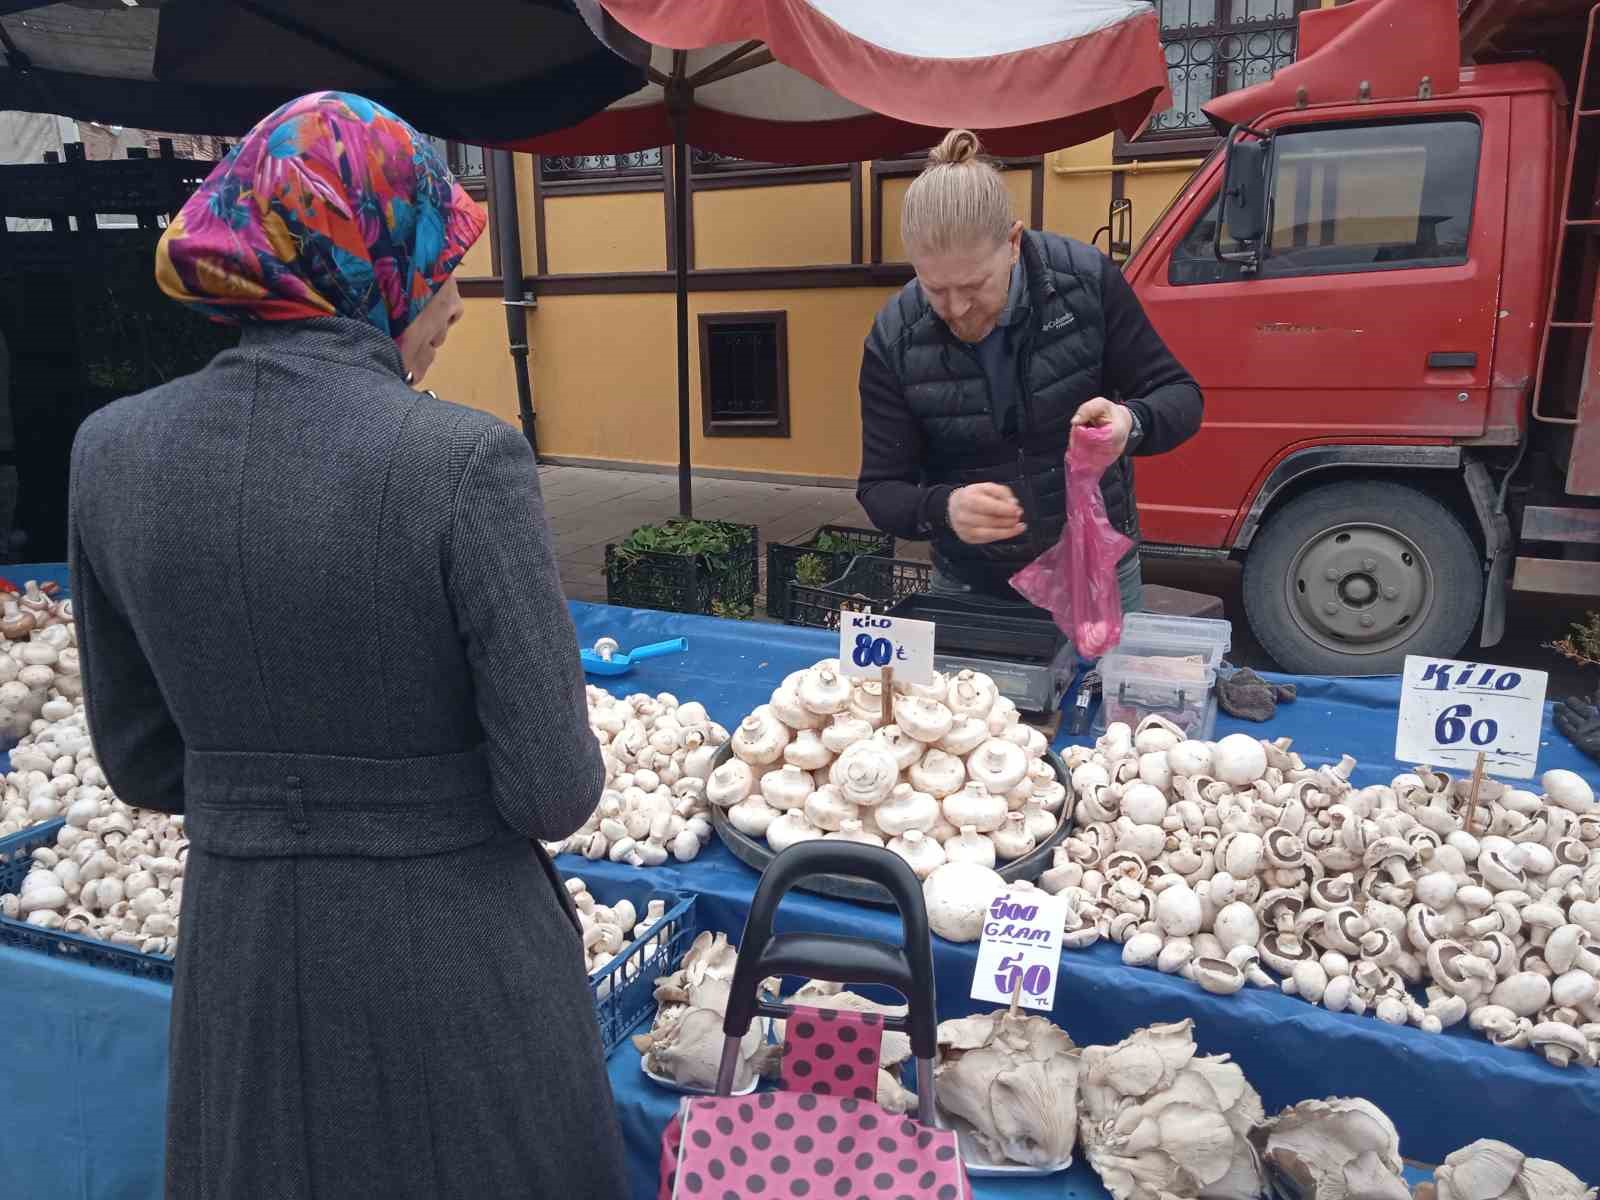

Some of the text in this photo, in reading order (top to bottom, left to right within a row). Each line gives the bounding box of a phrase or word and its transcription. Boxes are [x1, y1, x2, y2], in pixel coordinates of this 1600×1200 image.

[852, 633, 893, 668] 80
[1434, 703, 1498, 746] 60
[990, 894, 1039, 921] 500
[984, 922, 1051, 942] GRAM
[994, 951, 1051, 996] 50
